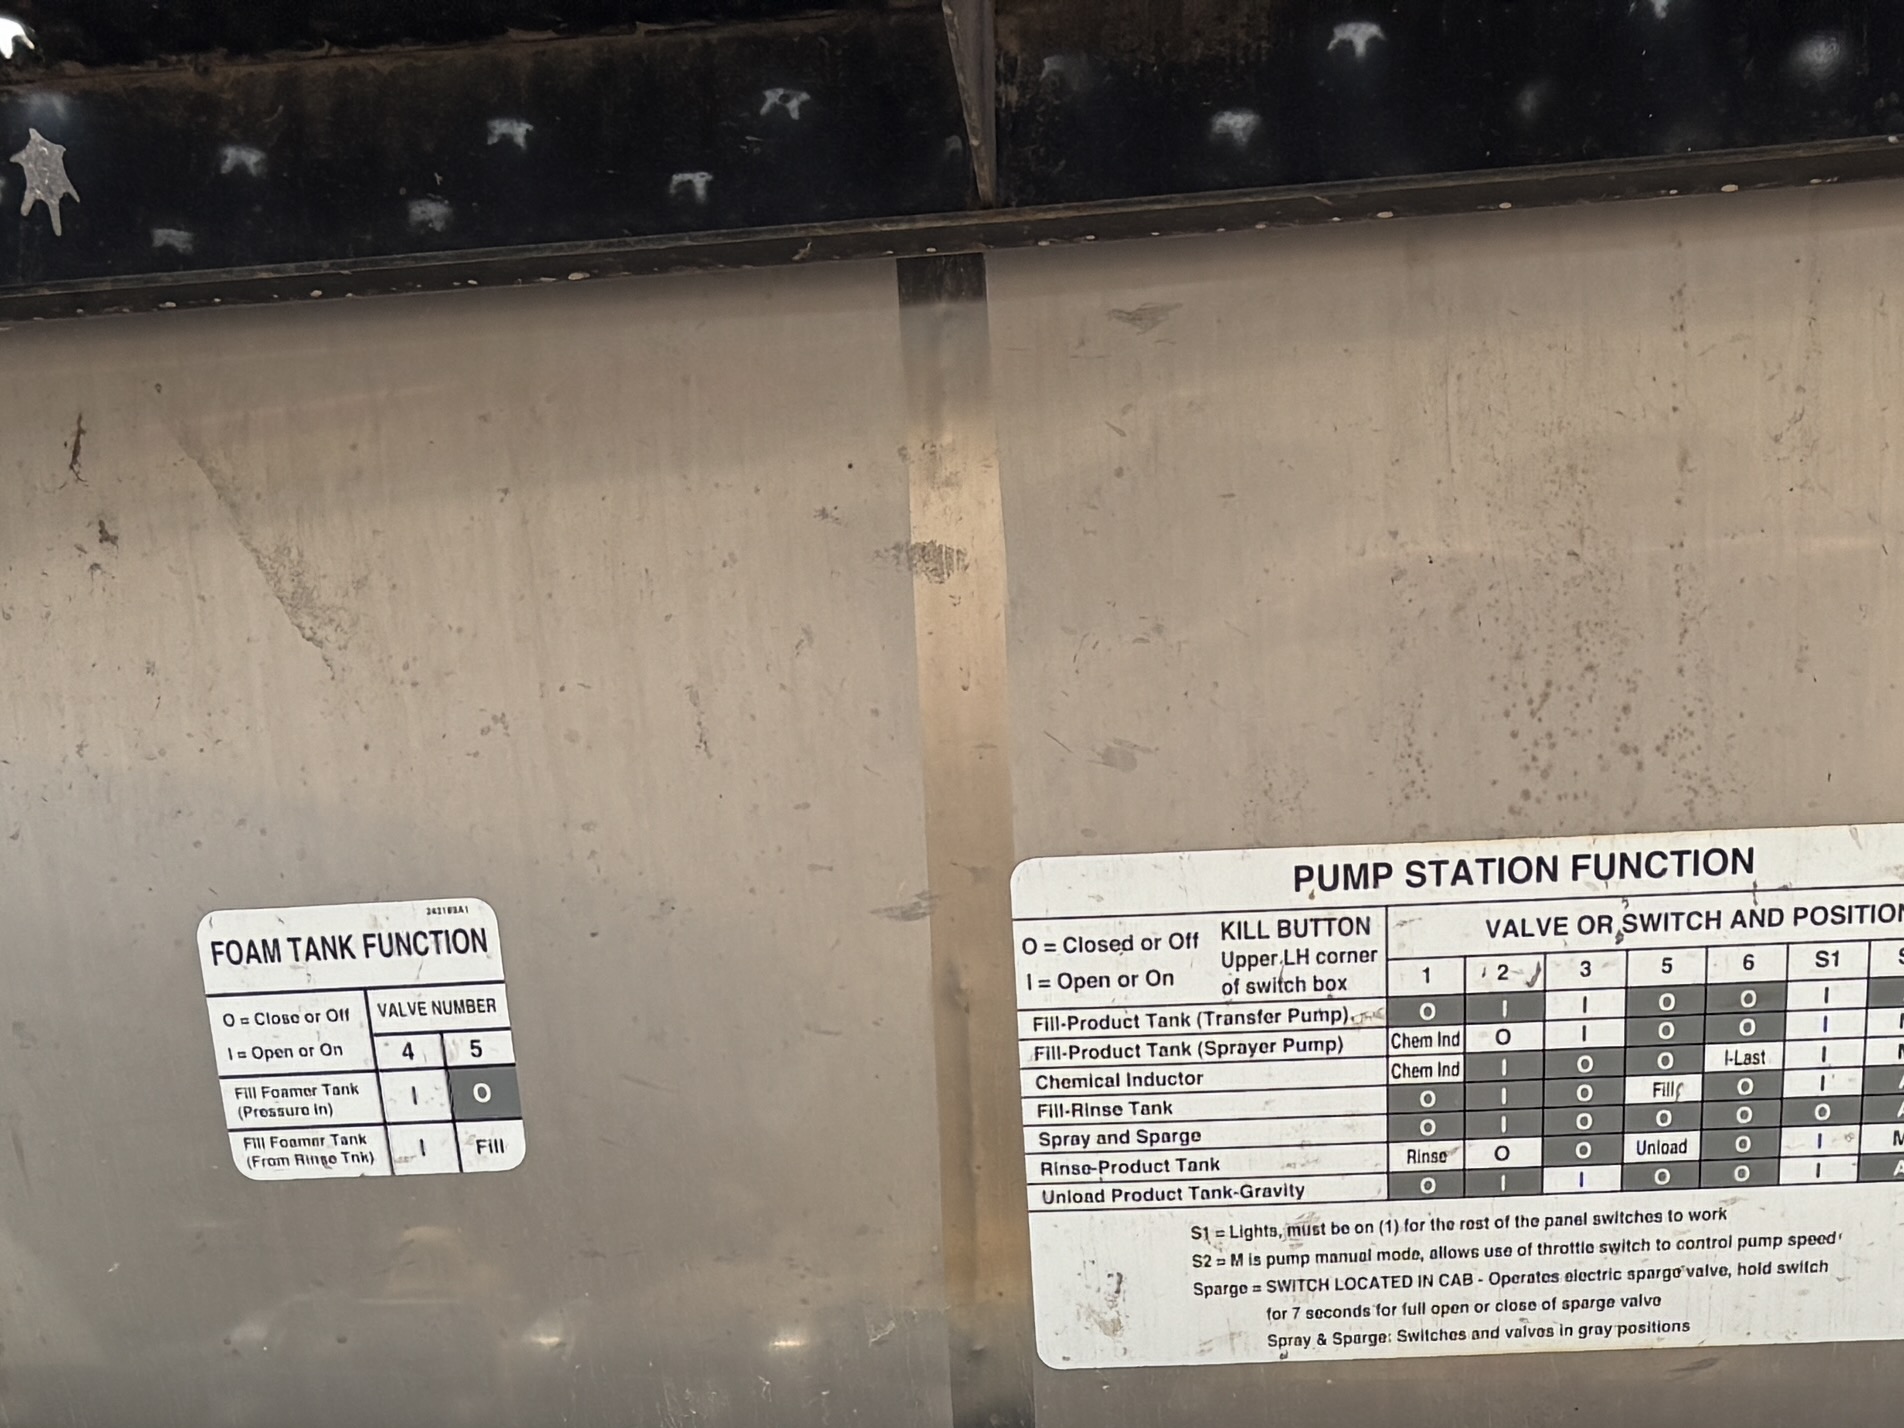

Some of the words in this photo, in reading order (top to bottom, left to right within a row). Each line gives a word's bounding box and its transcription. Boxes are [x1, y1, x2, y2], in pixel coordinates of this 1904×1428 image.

[1295, 863, 1392, 892] PUMP
[1406, 855, 1557, 888] STATION
[1572, 847, 1753, 881] FUNCTION
[1221, 920, 1270, 940] KILL
[1278, 917, 1370, 938] BUTTON
[1486, 917, 1568, 938] VALVE
[1578, 915, 1612, 935] OR
[1623, 910, 1721, 933] SWITCH
[1731, 908, 1784, 928] AND
[211, 938, 281, 966] FOAM
[287, 935, 356, 962] TANK
[363, 928, 487, 958] FUNCTION
[1044, 944, 1056, 952] =
[1063, 935, 1133, 955] Closed
[1141, 938, 1161, 950] or
[1169, 932, 1198, 949] Off
[1222, 951, 1278, 972] Upper
[1284, 948, 1309, 965] LH
[1316, 950, 1377, 964] corner
[1423, 967, 1429, 983] 1
[1498, 964, 1508, 980] 2
[1581, 961, 1591, 977] 3
[1662, 957, 1672, 973] 5
[1743, 954, 1754, 970] 6
[1816, 951, 1839, 967] S1
[1039, 980, 1050, 988] =
[1058, 973, 1110, 993] Open
[1118, 975, 1138, 987] or
[1146, 969, 1173, 986] On
[1222, 978, 1239, 995] of
[1246, 976, 1306, 994] switch
[1313, 975, 1346, 991] box
[255, 1012, 299, 1025] Close
[305, 1013, 320, 1023] or
[326, 1008, 349, 1022] Off
[377, 1002, 427, 1017] VALVE
[432, 998, 496, 1015] NUMBER
[1034, 1015, 1139, 1031] Fill-Product
[1146, 1012, 1190, 1028] Tank
[1197, 1009, 1281, 1029] (Transfer
[1289, 1006, 1348, 1025] Pump)
[252, 1046, 293, 1062] Open
[299, 1047, 314, 1057] or
[320, 1043, 342, 1056] On
[402, 1042, 414, 1060] 4
[471, 1040, 482, 1057] 5
[1035, 1044, 1140, 1061] Fill-Product
[1147, 1042, 1191, 1057] Tank
[1198, 1041, 1276, 1058] (Sprayer
[1284, 1036, 1343, 1055] Pump)
[1036, 1073, 1119, 1089] Chemical
[1127, 1072, 1203, 1087] Inductor
[235, 1087, 256, 1099] Fill
[261, 1086, 317, 1098] Foamer
[322, 1083, 359, 1095] Tank
[238, 1106, 309, 1120] (Pressure
[1038, 1103, 1123, 1118] Fill-Rinse
[1129, 1101, 1172, 1115] Tank
[244, 1137, 265, 1150] Fill
[330, 1134, 366, 1145] Tank
[476, 1139, 504, 1154] Fill
[1039, 1132, 1090, 1149] Spray
[1097, 1130, 1129, 1144] and
[1137, 1129, 1201, 1146] Sparge
[247, 1156, 289, 1169] (From
[295, 1154, 337, 1169] Rinse
[1041, 1160, 1169, 1175] Rinse-Product
[1176, 1158, 1219, 1172] Tank
[1043, 1189, 1104, 1204] Unload
[1112, 1188, 1182, 1202] Product
[1189, 1183, 1304, 1200] Tank-Gravity
[1268, 1334, 1311, 1349] Spray
[1317, 1333, 1326, 1345] &
[1333, 1332, 1391, 1347] Sparge:
[1397, 1329, 1466, 1342] Switches
[1472, 1326, 1499, 1340] and
[1505, 1325, 1554, 1338] valves
[1560, 1324, 1573, 1336] in
[1579, 1326, 1612, 1339] gray
[1618, 1321, 1690, 1337] positions
